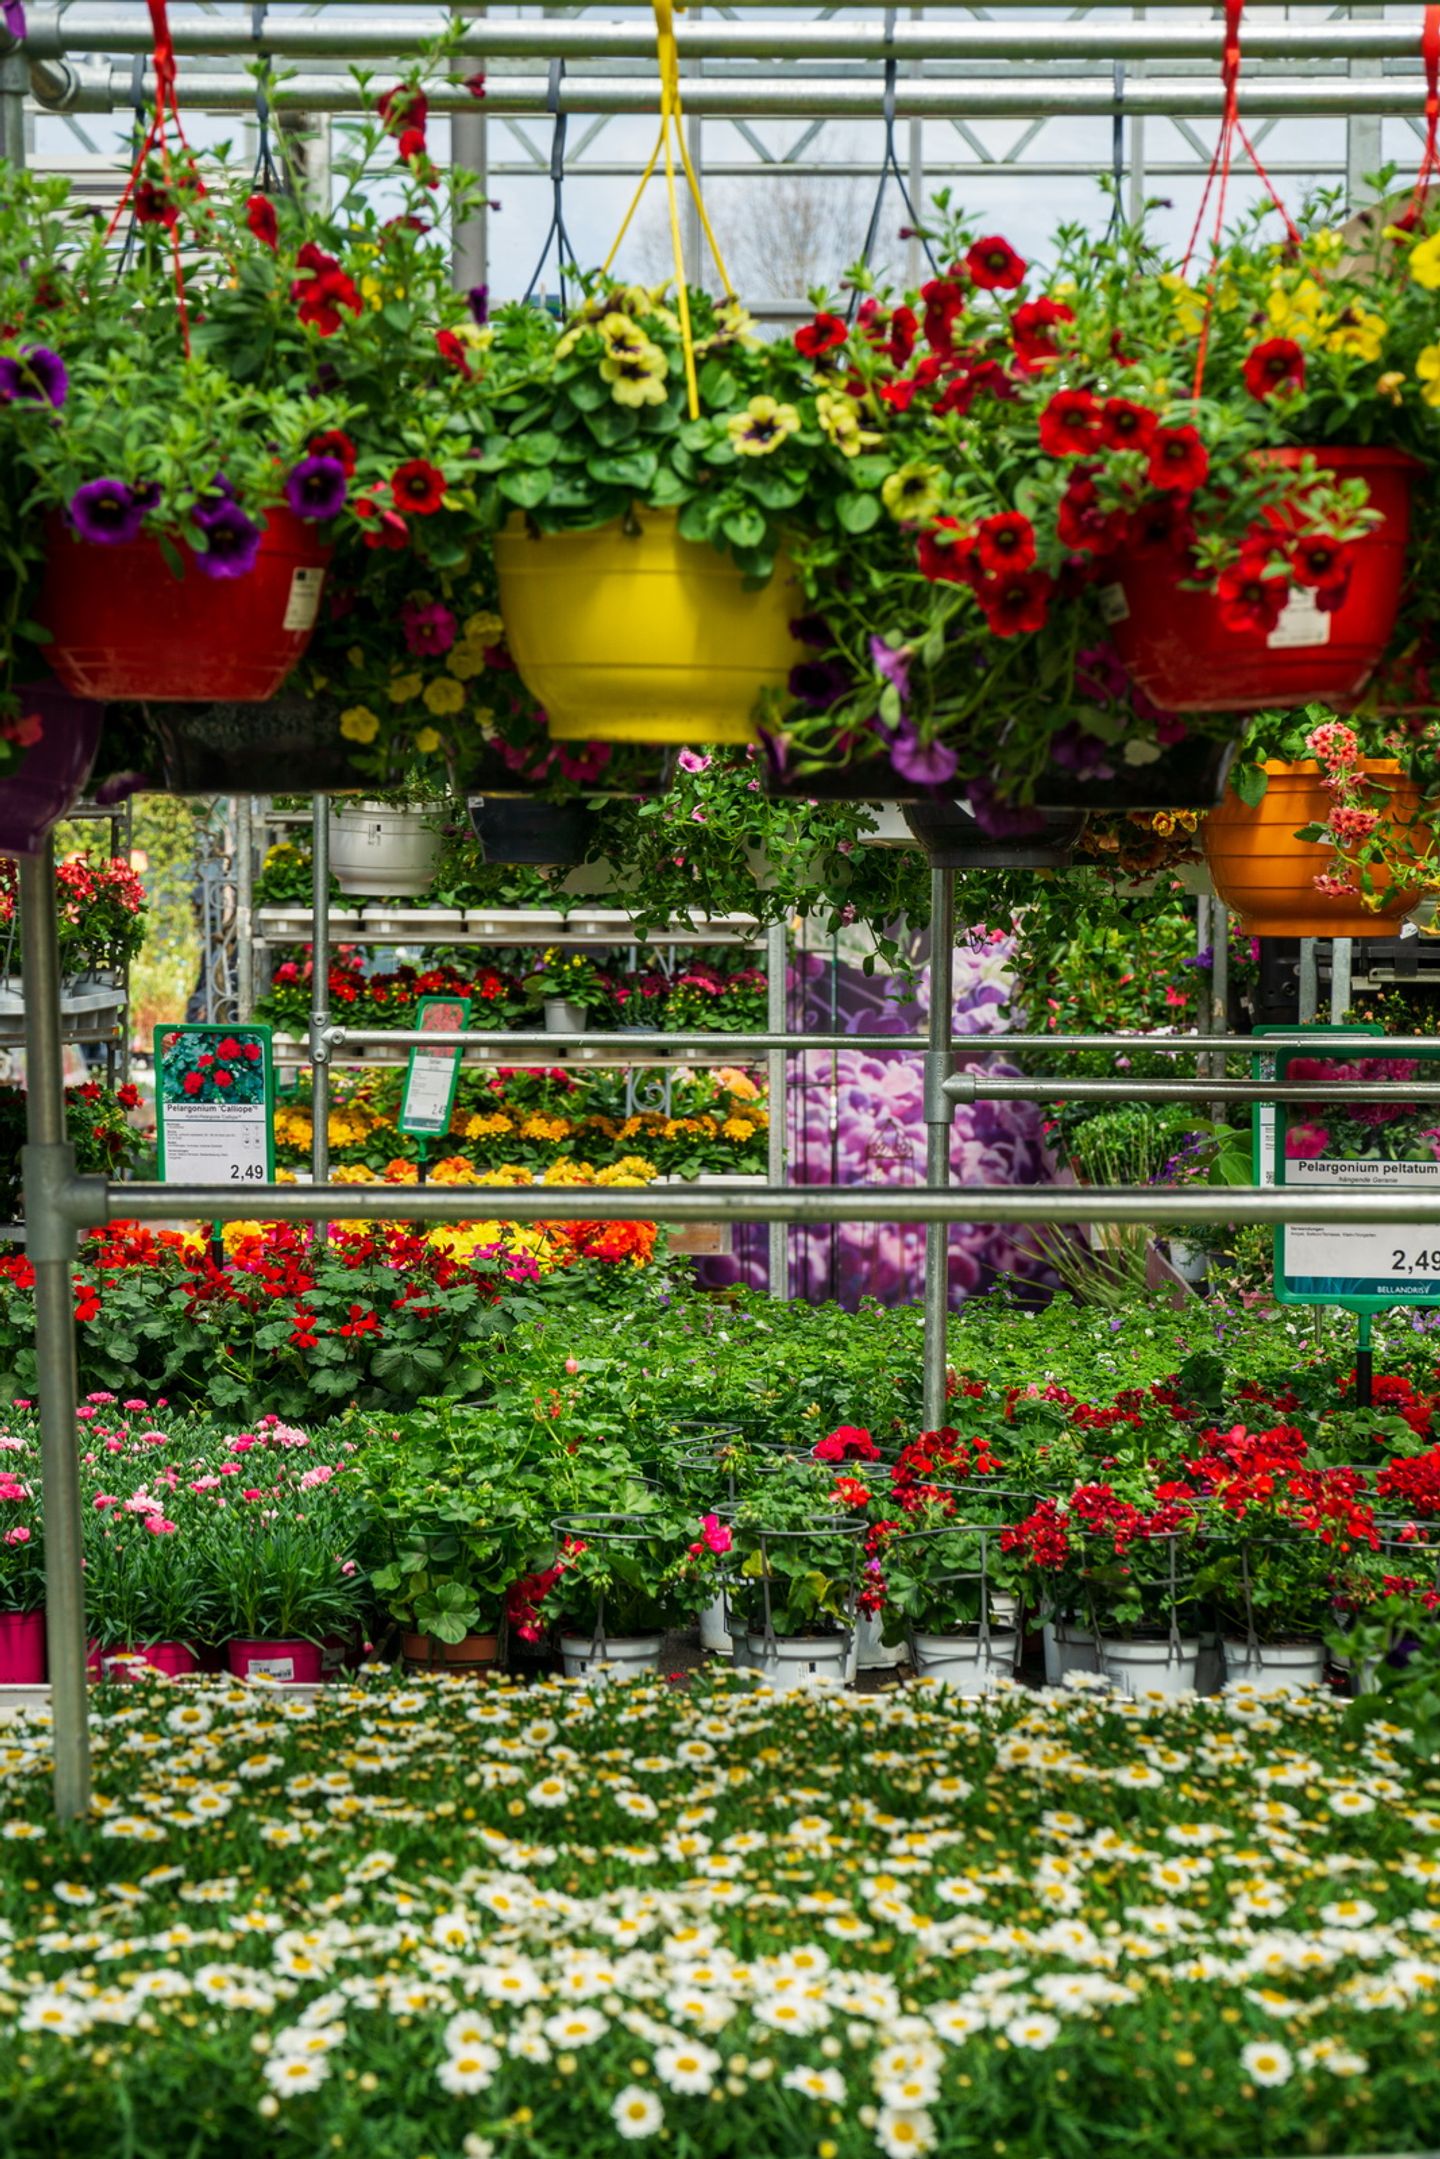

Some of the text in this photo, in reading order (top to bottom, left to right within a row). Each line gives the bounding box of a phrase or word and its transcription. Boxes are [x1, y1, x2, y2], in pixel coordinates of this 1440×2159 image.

[167, 1104, 216, 1113] Pelargonium
[230, 1164, 264, 1180] 2,49
[1298, 1161, 1438, 1175] Pelargonium peltatum
[1391, 1249, 1440, 1274] 2,49
